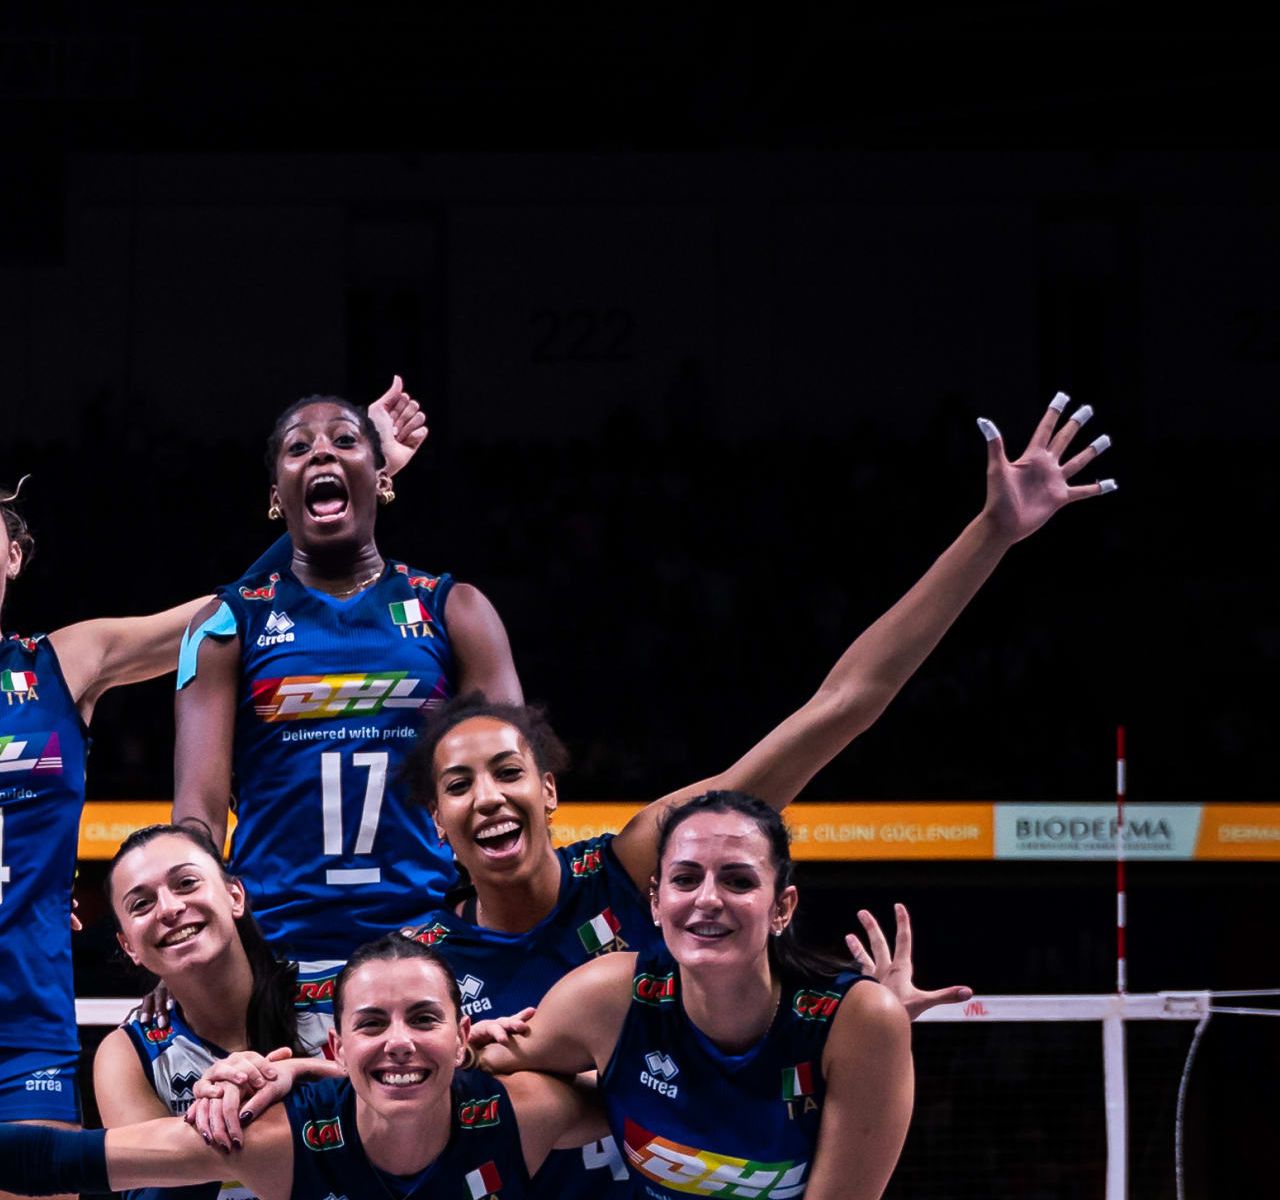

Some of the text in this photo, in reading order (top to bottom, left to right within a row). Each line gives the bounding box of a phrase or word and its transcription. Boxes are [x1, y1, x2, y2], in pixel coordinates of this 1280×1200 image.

[257, 630, 295, 647] errea
[400, 624, 435, 640] ITA
[6, 686, 39, 706] ITA
[276, 678, 428, 716] DHL
[282, 726, 419, 743] Delivered with pride.
[320, 752, 389, 856] 17
[1015, 818, 1172, 840] BIODERMA
[460, 997, 493, 1017] rrea
[25, 1077, 63, 1093] errea
[640, 1070, 679, 1100] errea
[641, 1142, 808, 1200] DHL
